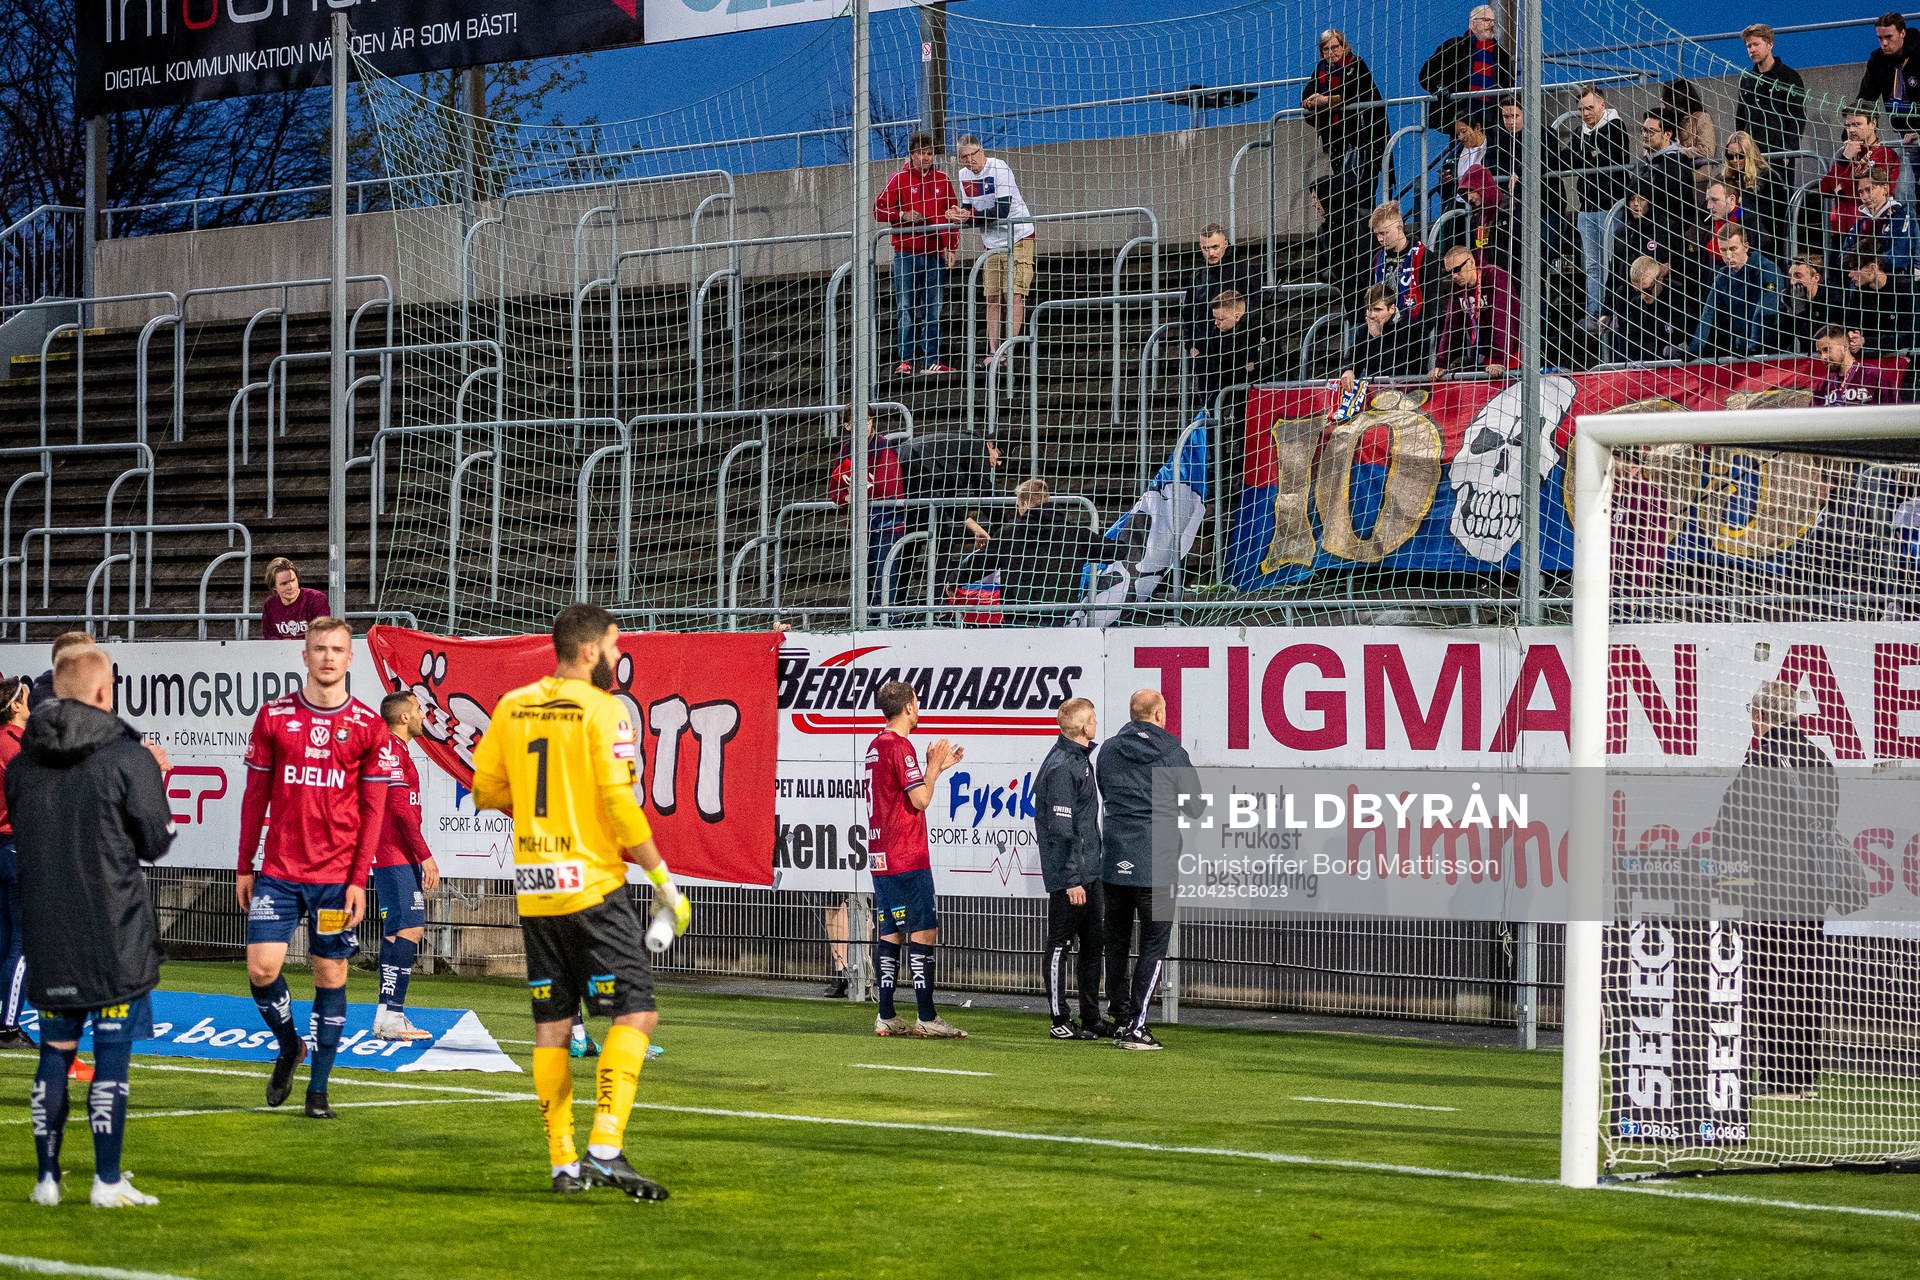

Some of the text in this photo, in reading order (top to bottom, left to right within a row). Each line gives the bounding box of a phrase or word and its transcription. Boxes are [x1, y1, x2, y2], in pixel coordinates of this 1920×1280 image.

[105, 12, 517, 91] DIGITAL KOMMUNIKATION NÄ DEN ÄR SOM BÄST!
[1134, 643, 1698, 757] TIGMAN
[142, 731, 161, 746] TER
[284, 764, 346, 790] BJELIN
[527, 737, 549, 818] 1
[796, 778, 825, 798] ALLA
[473, 817, 481, 832] &
[971, 829, 981, 845] &
[1221, 824, 1302, 850] Frukost
[515, 867, 556, 890] BESAB
[1205, 860, 1319, 898] Beställning
[380, 963, 401, 996] MIKE
[880, 955, 894, 989] MIKE
[910, 954, 926, 989] MIKE
[1627, 890, 1676, 1109] SELECT
[1706, 897, 1744, 1112] SELECT
[176, 1016, 412, 1057] bosder
[598, 1067, 614, 1114] MIKE
[90, 1081, 117, 1135] MIKE
[1642, 1123, 1680, 1138] OBOS
[1716, 1125, 1746, 1139] OBOS
